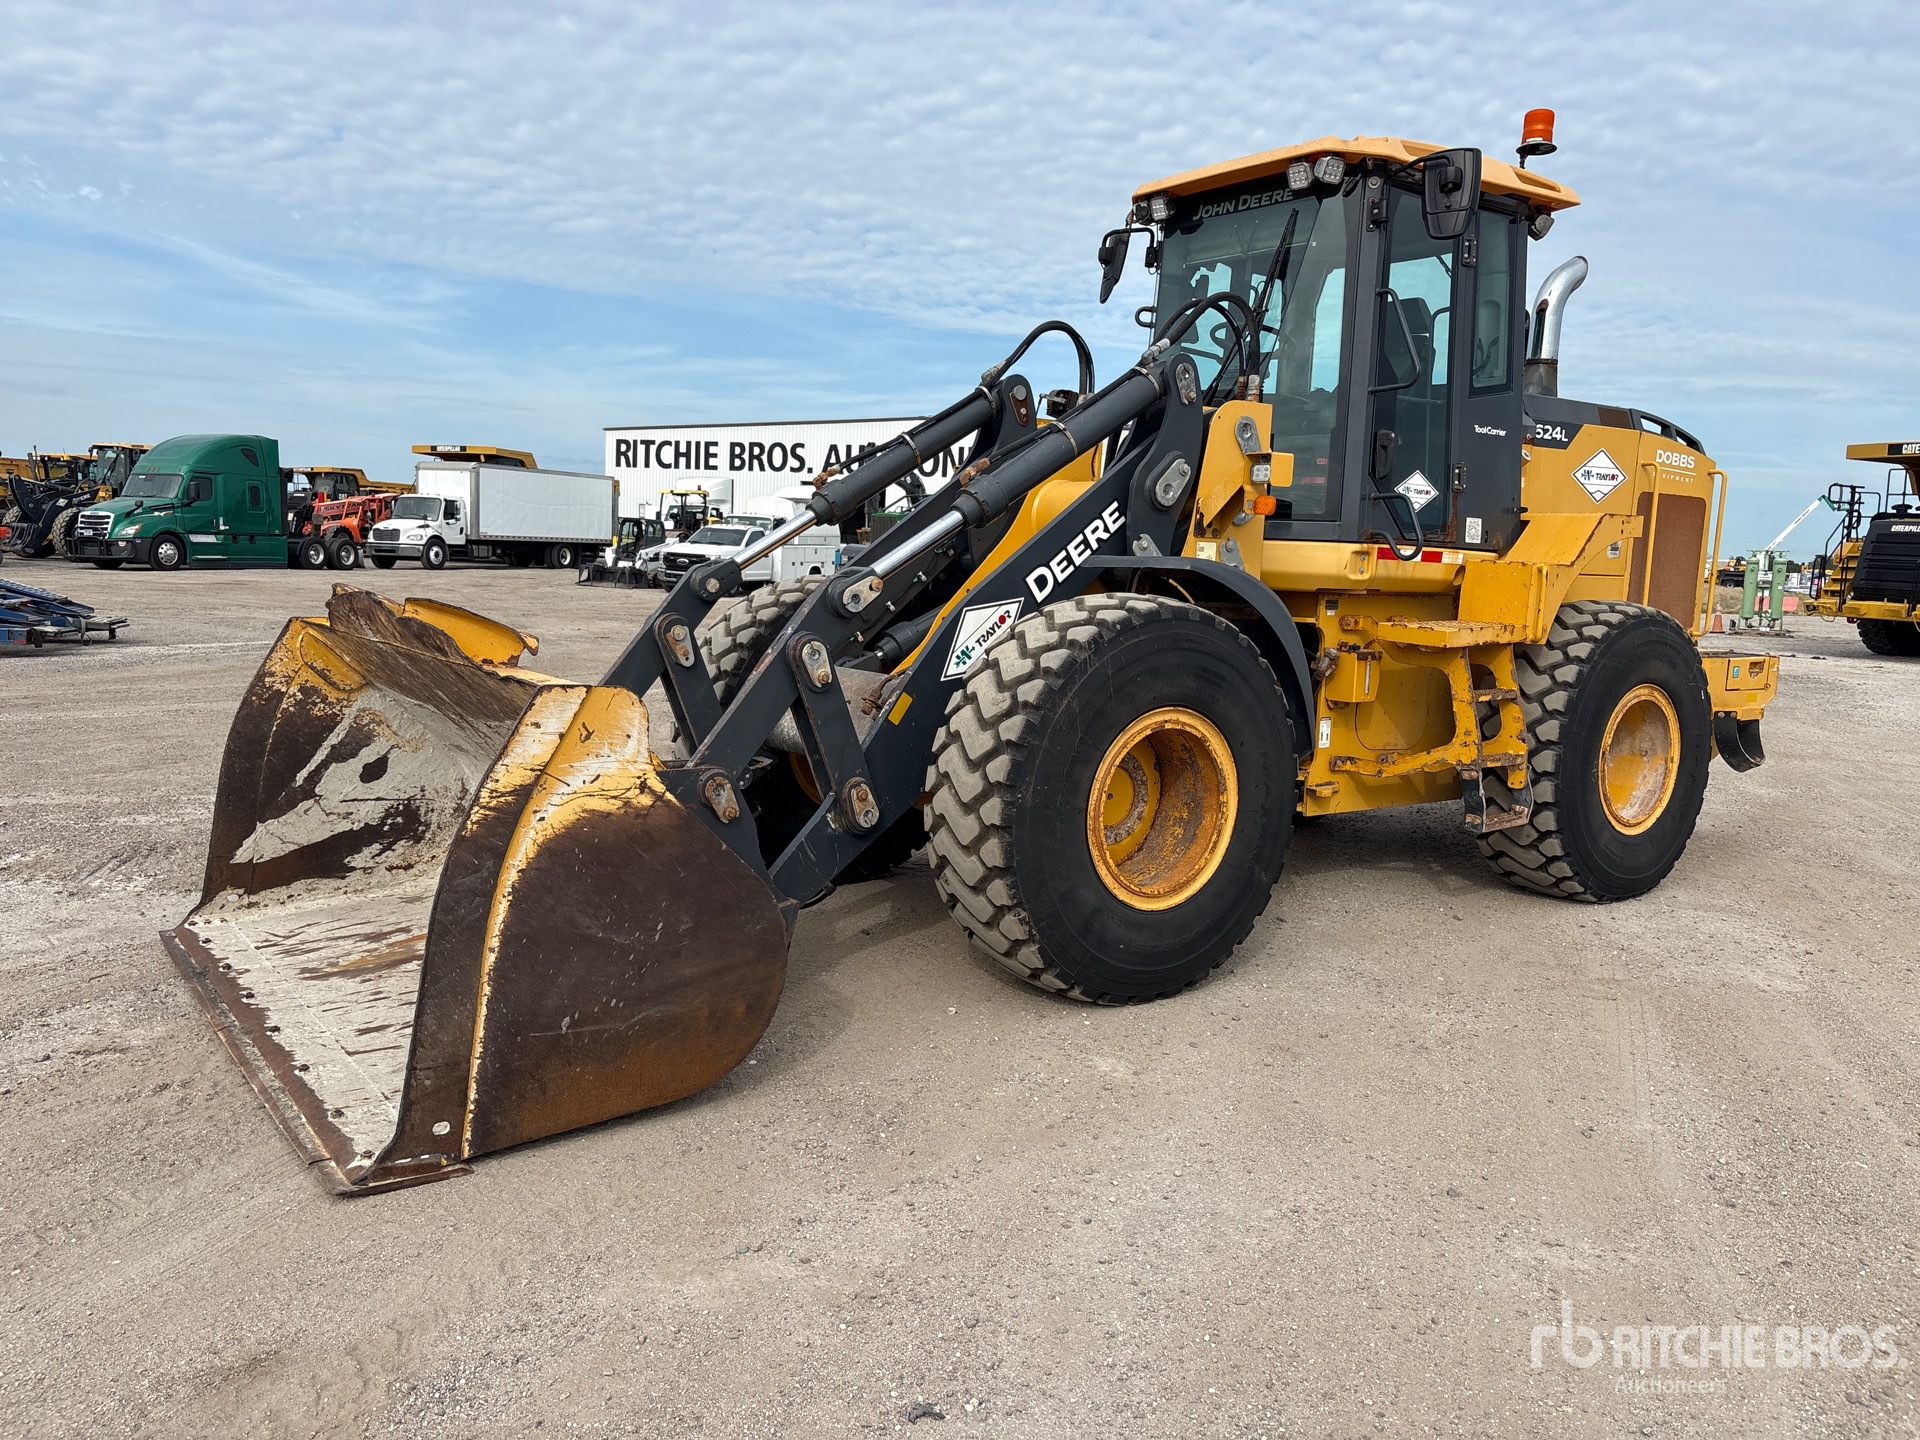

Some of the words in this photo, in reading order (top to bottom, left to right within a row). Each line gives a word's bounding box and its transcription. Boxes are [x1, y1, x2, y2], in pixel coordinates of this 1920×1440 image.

[1193, 201, 1235, 220] JOHN
[1238, 188, 1293, 210] DEERE
[1474, 424, 1486, 434] Tool
[615, 438, 719, 471] RITCHIE
[729, 441, 813, 474] BROS.
[1656, 449, 1696, 469] DOBBS
[1652, 471, 1695, 484] EUIPMENT
[1025, 500, 1126, 604] DEERE
[974, 609, 1013, 648] TRAYLOR
